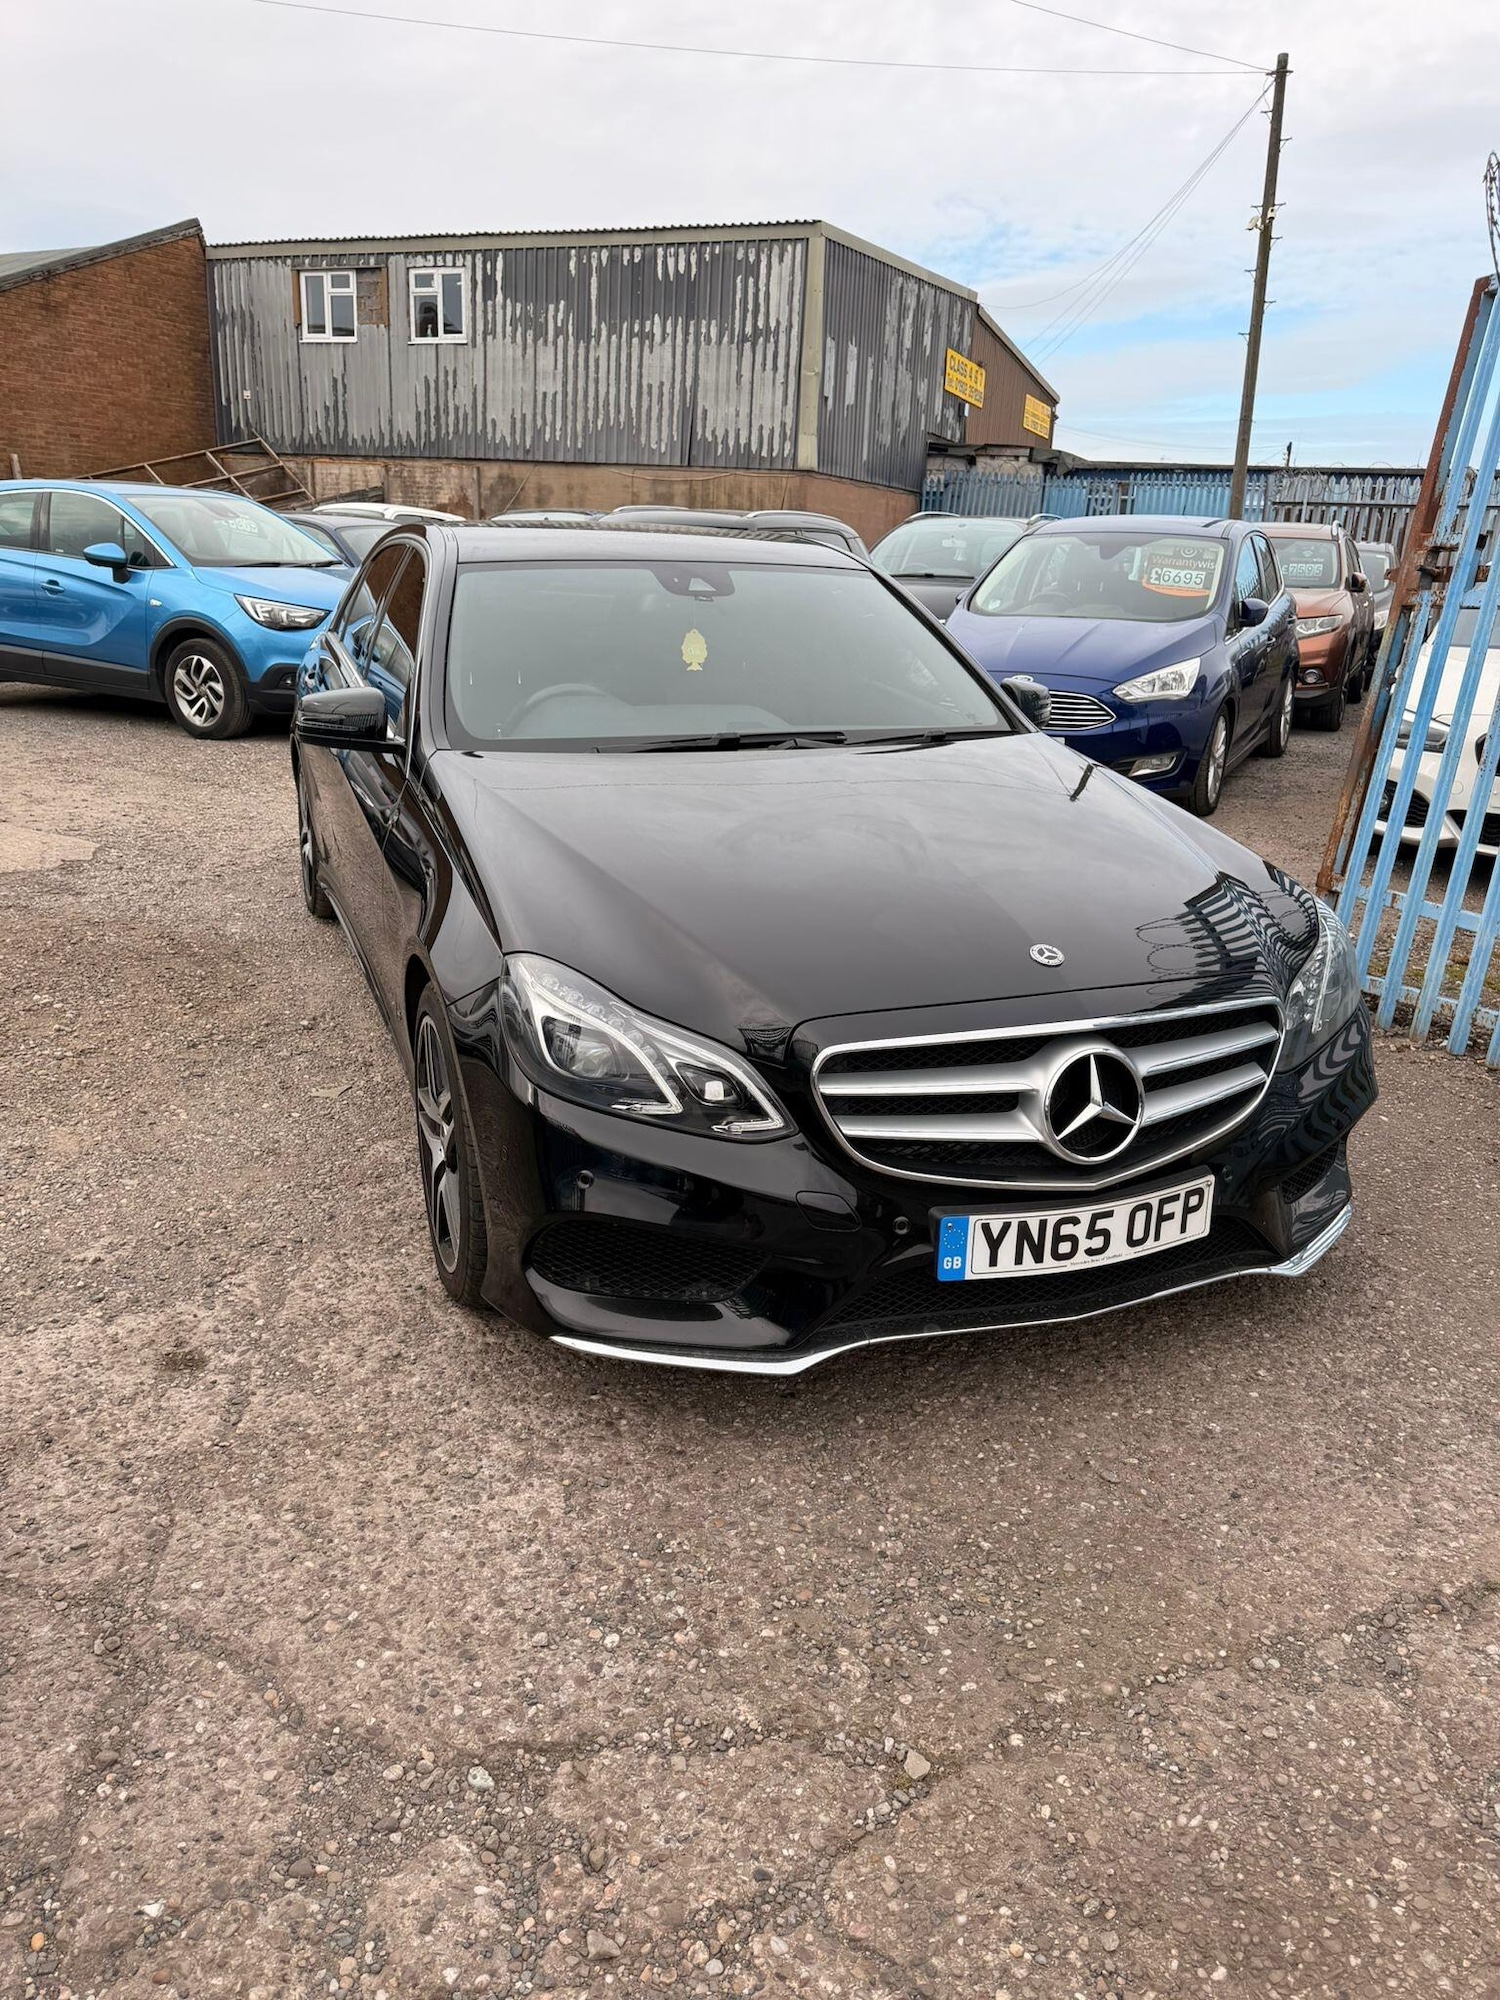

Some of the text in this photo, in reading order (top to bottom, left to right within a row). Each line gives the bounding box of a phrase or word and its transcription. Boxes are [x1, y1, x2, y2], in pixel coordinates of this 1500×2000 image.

[1152, 555, 1215, 569] Warrantywis
[1150, 567, 1204, 586] £6695
[981, 1187, 1204, 1268] YN65 OFP
[943, 1256, 961, 1269] GB
